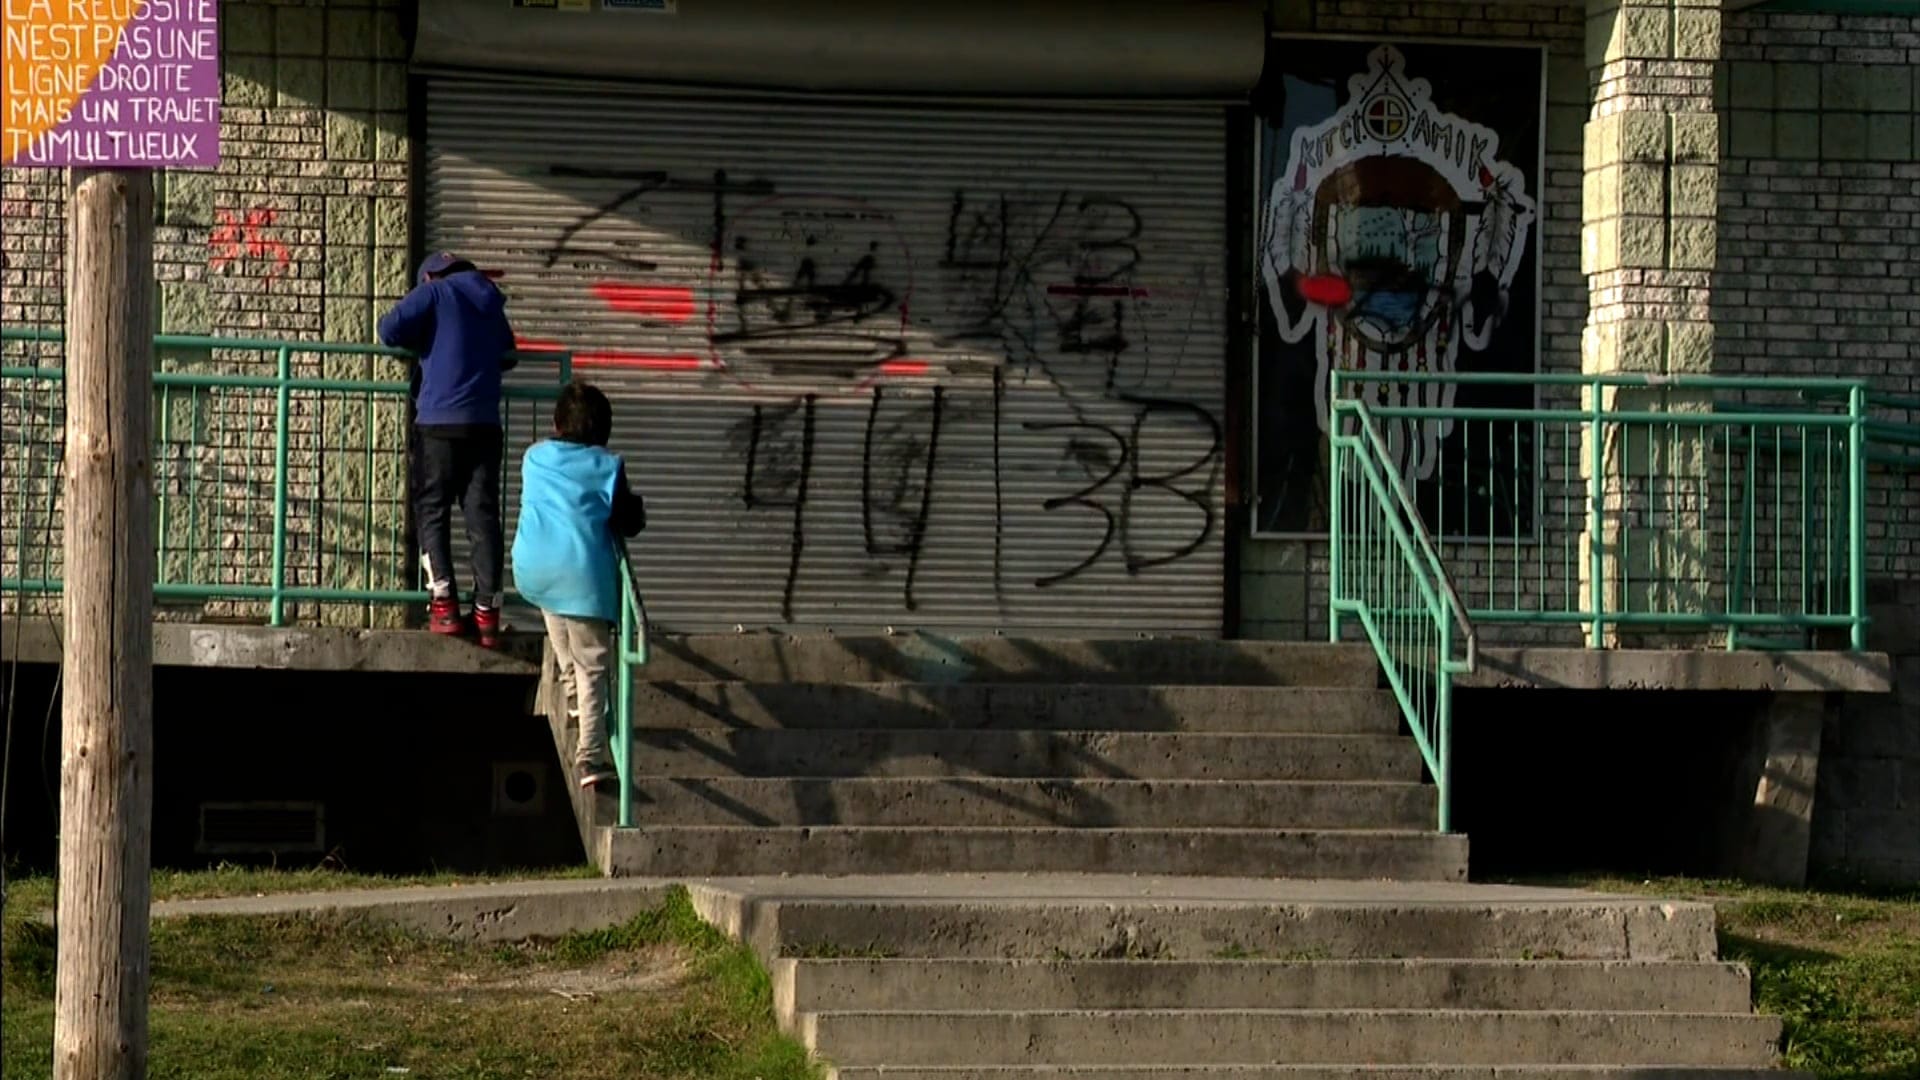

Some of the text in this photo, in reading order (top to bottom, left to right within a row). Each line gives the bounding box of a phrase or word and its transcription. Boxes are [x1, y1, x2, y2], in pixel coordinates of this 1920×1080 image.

[5, 0, 53, 21] LA
[6, 22, 216, 61] N'EST PAS UNE
[8, 63, 193, 95] LIGNE DROITE
[11, 97, 219, 126] MAIS UN TRAJET
[5, 128, 199, 164] TUMULTUEUX
[1411, 109, 1488, 182] AMIK
